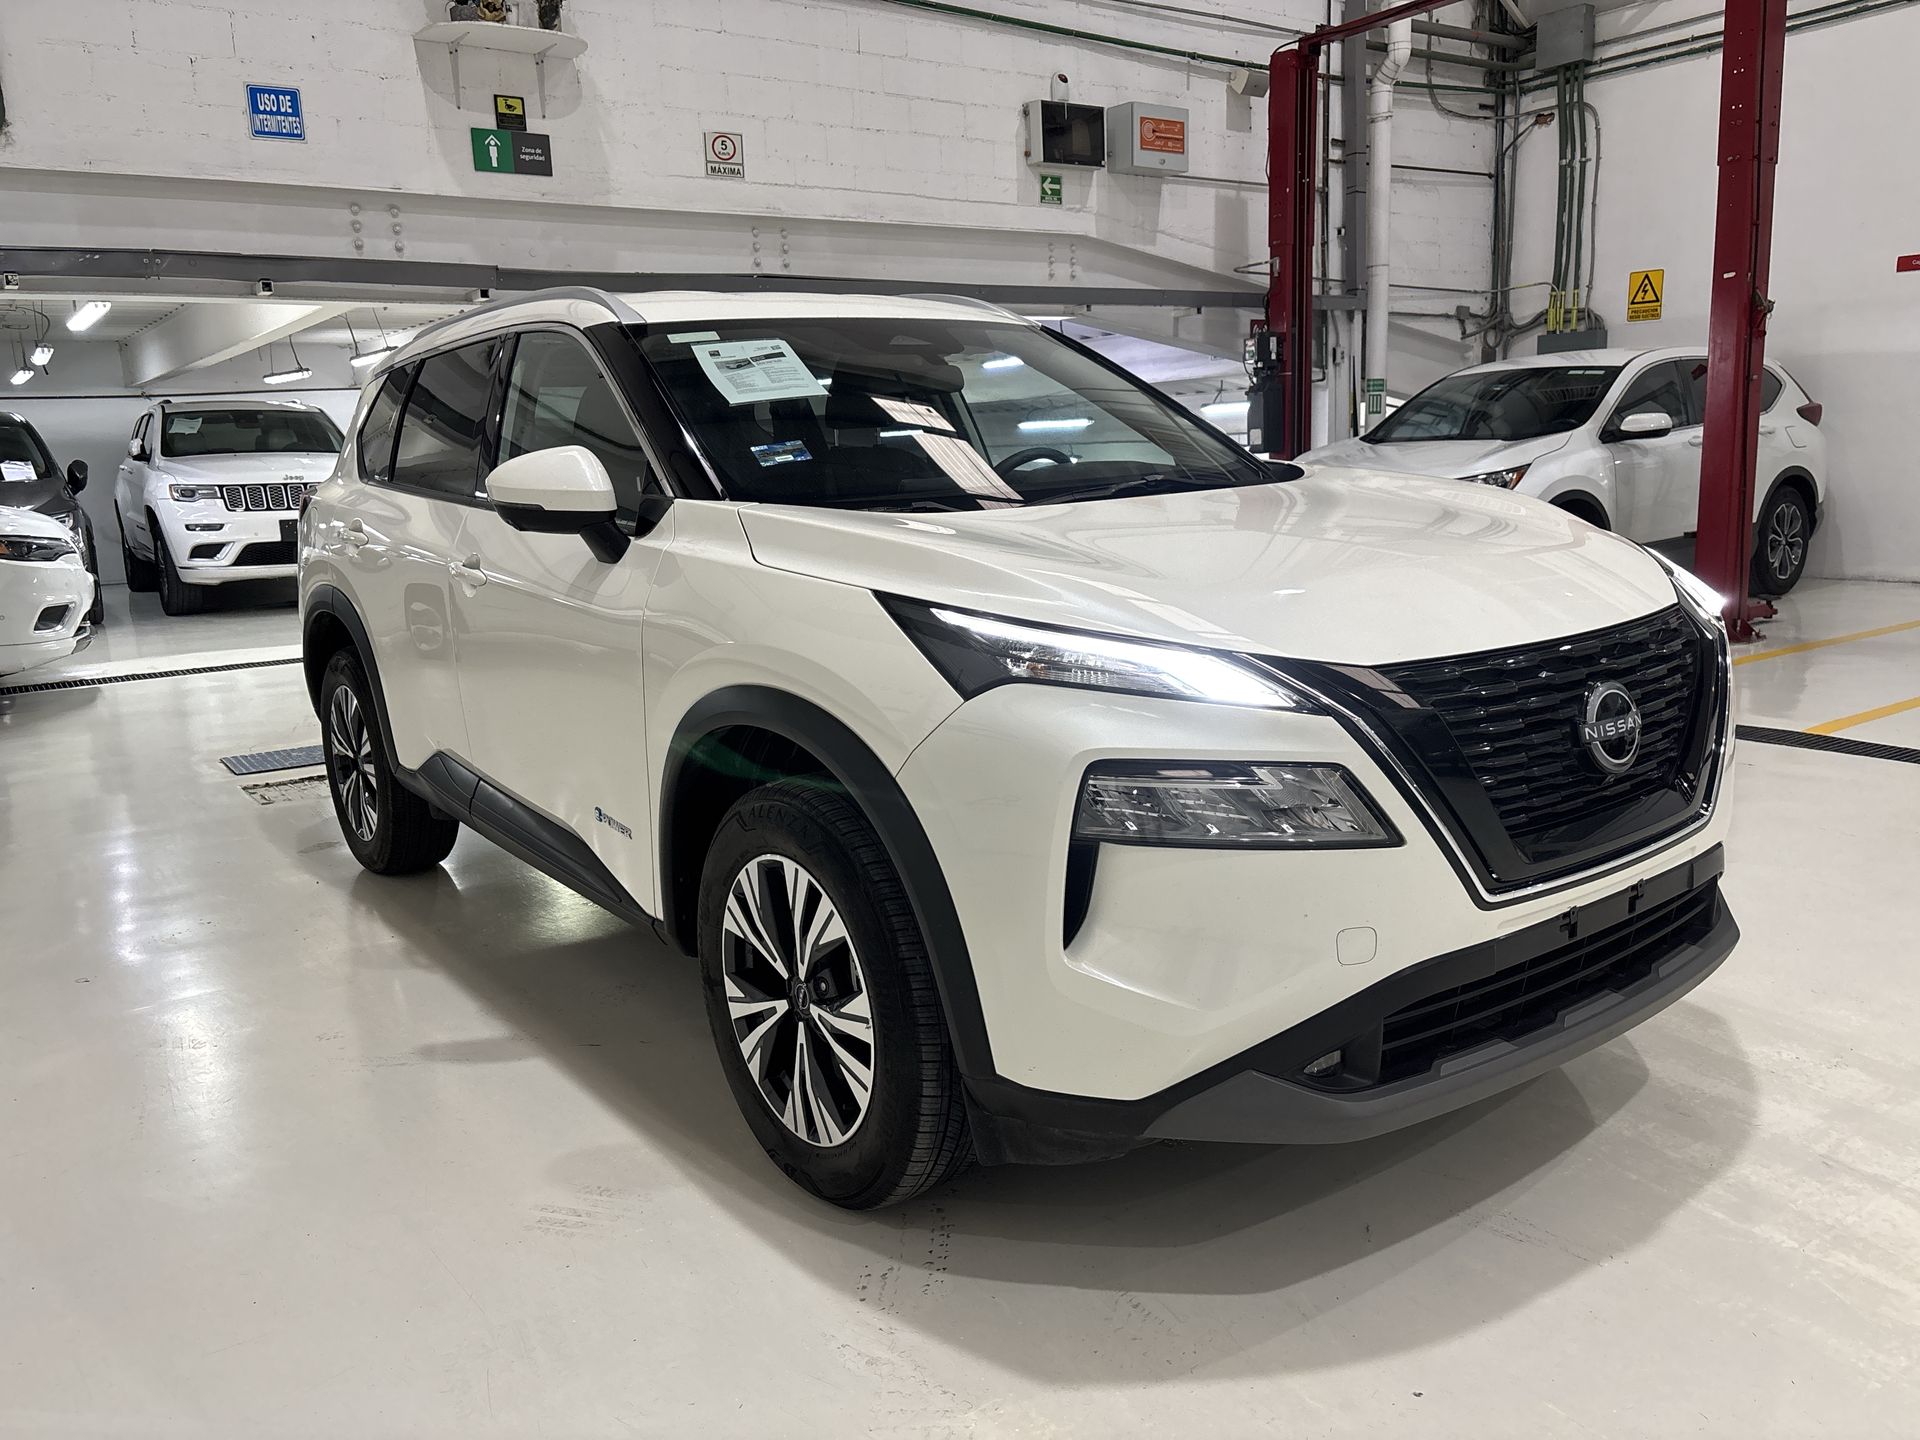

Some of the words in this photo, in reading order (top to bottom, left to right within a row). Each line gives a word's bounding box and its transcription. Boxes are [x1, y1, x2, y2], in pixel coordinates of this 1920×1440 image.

[256, 92, 278, 112] USO
[278, 94, 293, 114] DE
[252, 113, 302, 135] INTERMITENTES
[521, 146, 535, 155] Zona
[720, 139, 728, 151] 5
[519, 153, 546, 162] seguridad
[710, 164, 742, 177] MÁXIMA
[283, 474, 305, 482] Jeep
[1584, 712, 1642, 740] NISSAN
